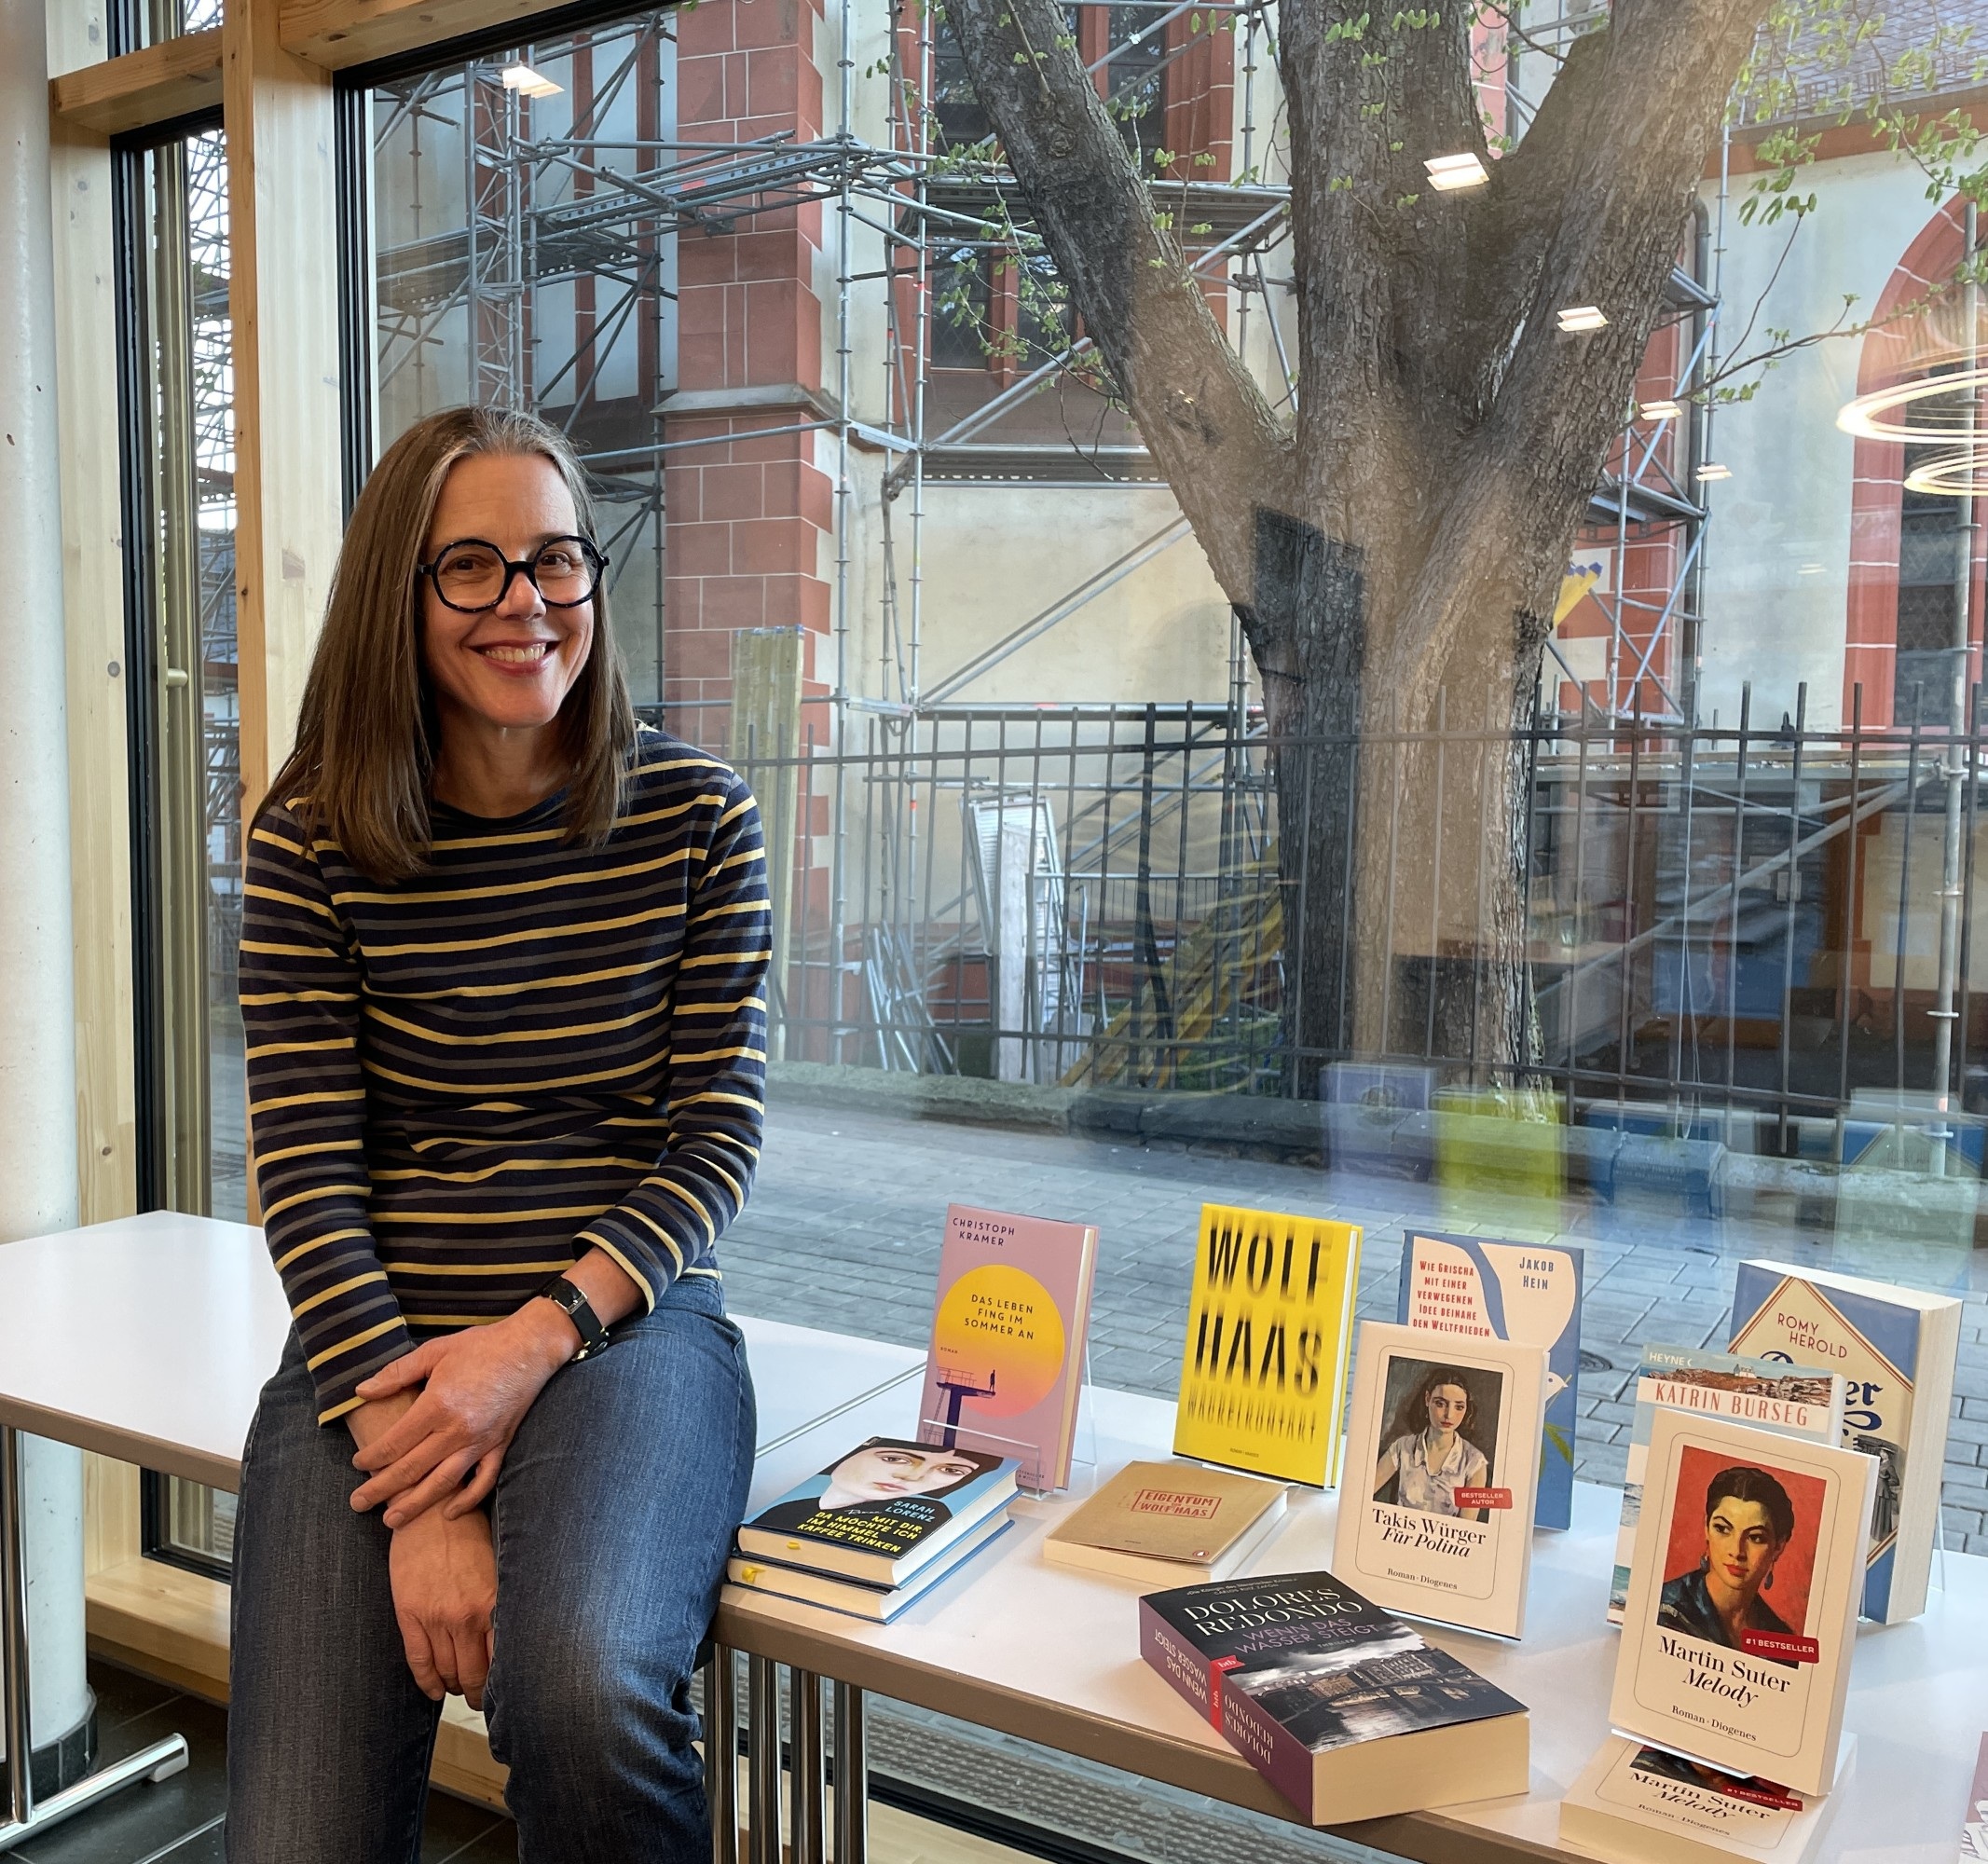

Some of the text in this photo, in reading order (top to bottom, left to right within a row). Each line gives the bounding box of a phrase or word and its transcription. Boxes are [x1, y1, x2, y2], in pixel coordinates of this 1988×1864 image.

[953, 1217, 1015, 1236] CHRISTOPH
[959, 1231, 1005, 1247] KRAMER
[1207, 1213, 1332, 1305] WOLF
[1424, 1277, 1467, 1290] MIT EINER
[971, 1294, 1034, 1314] DAS LEBEN
[1418, 1290, 1473, 1306] VERWEGENEN
[978, 1308, 1023, 1324] FING IM
[1413, 1318, 1429, 1329] DEN
[1441, 1308, 1477, 1321] BEINAHE
[1777, 1312, 1819, 1334] ROMY
[965, 1317, 1035, 1340] SOMMER AN
[1194, 1297, 1323, 1399] HAAS
[1789, 1331, 1847, 1359] HEROLD
[1649, 1351, 1685, 1367] HEYNE
[1655, 1382, 1721, 1411] KATRIN
[1731, 1395, 1808, 1427] BURSEG
[894, 1501, 935, 1514] SARAH
[1141, 1502, 1172, 1513] WOLF
[1174, 1506, 1208, 1517] HAAS
[1145, 1491, 1213, 1506] EIGENTUM
[871, 1515, 898, 1526] MIT
[884, 1506, 936, 1522] LORENZ
[806, 1517, 879, 1539] IM HIMMEL
[815, 1512, 918, 1540] DA MÖCHTE ICH
[1372, 1508, 1487, 1545] Takis Würger
[797, 1523, 901, 1553] KAFFEE TRINKEN
[1381, 1527, 1471, 1558] Für Polina
[1387, 1568, 1458, 1590] Roman Diogenes
[1183, 1588, 1341, 1620] DOLORES
[1195, 1601, 1363, 1636] REDONDO
[1242, 1618, 1351, 1641] WENN DAS
[1235, 1624, 1379, 1654] WASSER STEIGT
[1317, 1638, 1356, 1649] THRILLER
[1758, 1639, 1815, 1654] BESTSELLER
[1155, 1629, 1207, 1686] WASSER STEIGT
[1218, 1659, 1236, 1668] btb
[1658, 1635, 1791, 1693] Martin Suter
[1167, 1656, 1207, 1704] WENN DAS
[1681, 1667, 1760, 1708] Melody
[1225, 1694, 1273, 1749] REDONDO
[1671, 1705, 1757, 1742] Roman Diogenes
[1225, 1711, 1270, 1764] DOLORES
[1630, 1772, 1771, 1820] Martin Suter
[1652, 1790, 1736, 1820] Melody
[1739, 1790, 1799, 1807] BESTSELLER
[1638, 1803, 1730, 1836] Roman Diogenes
